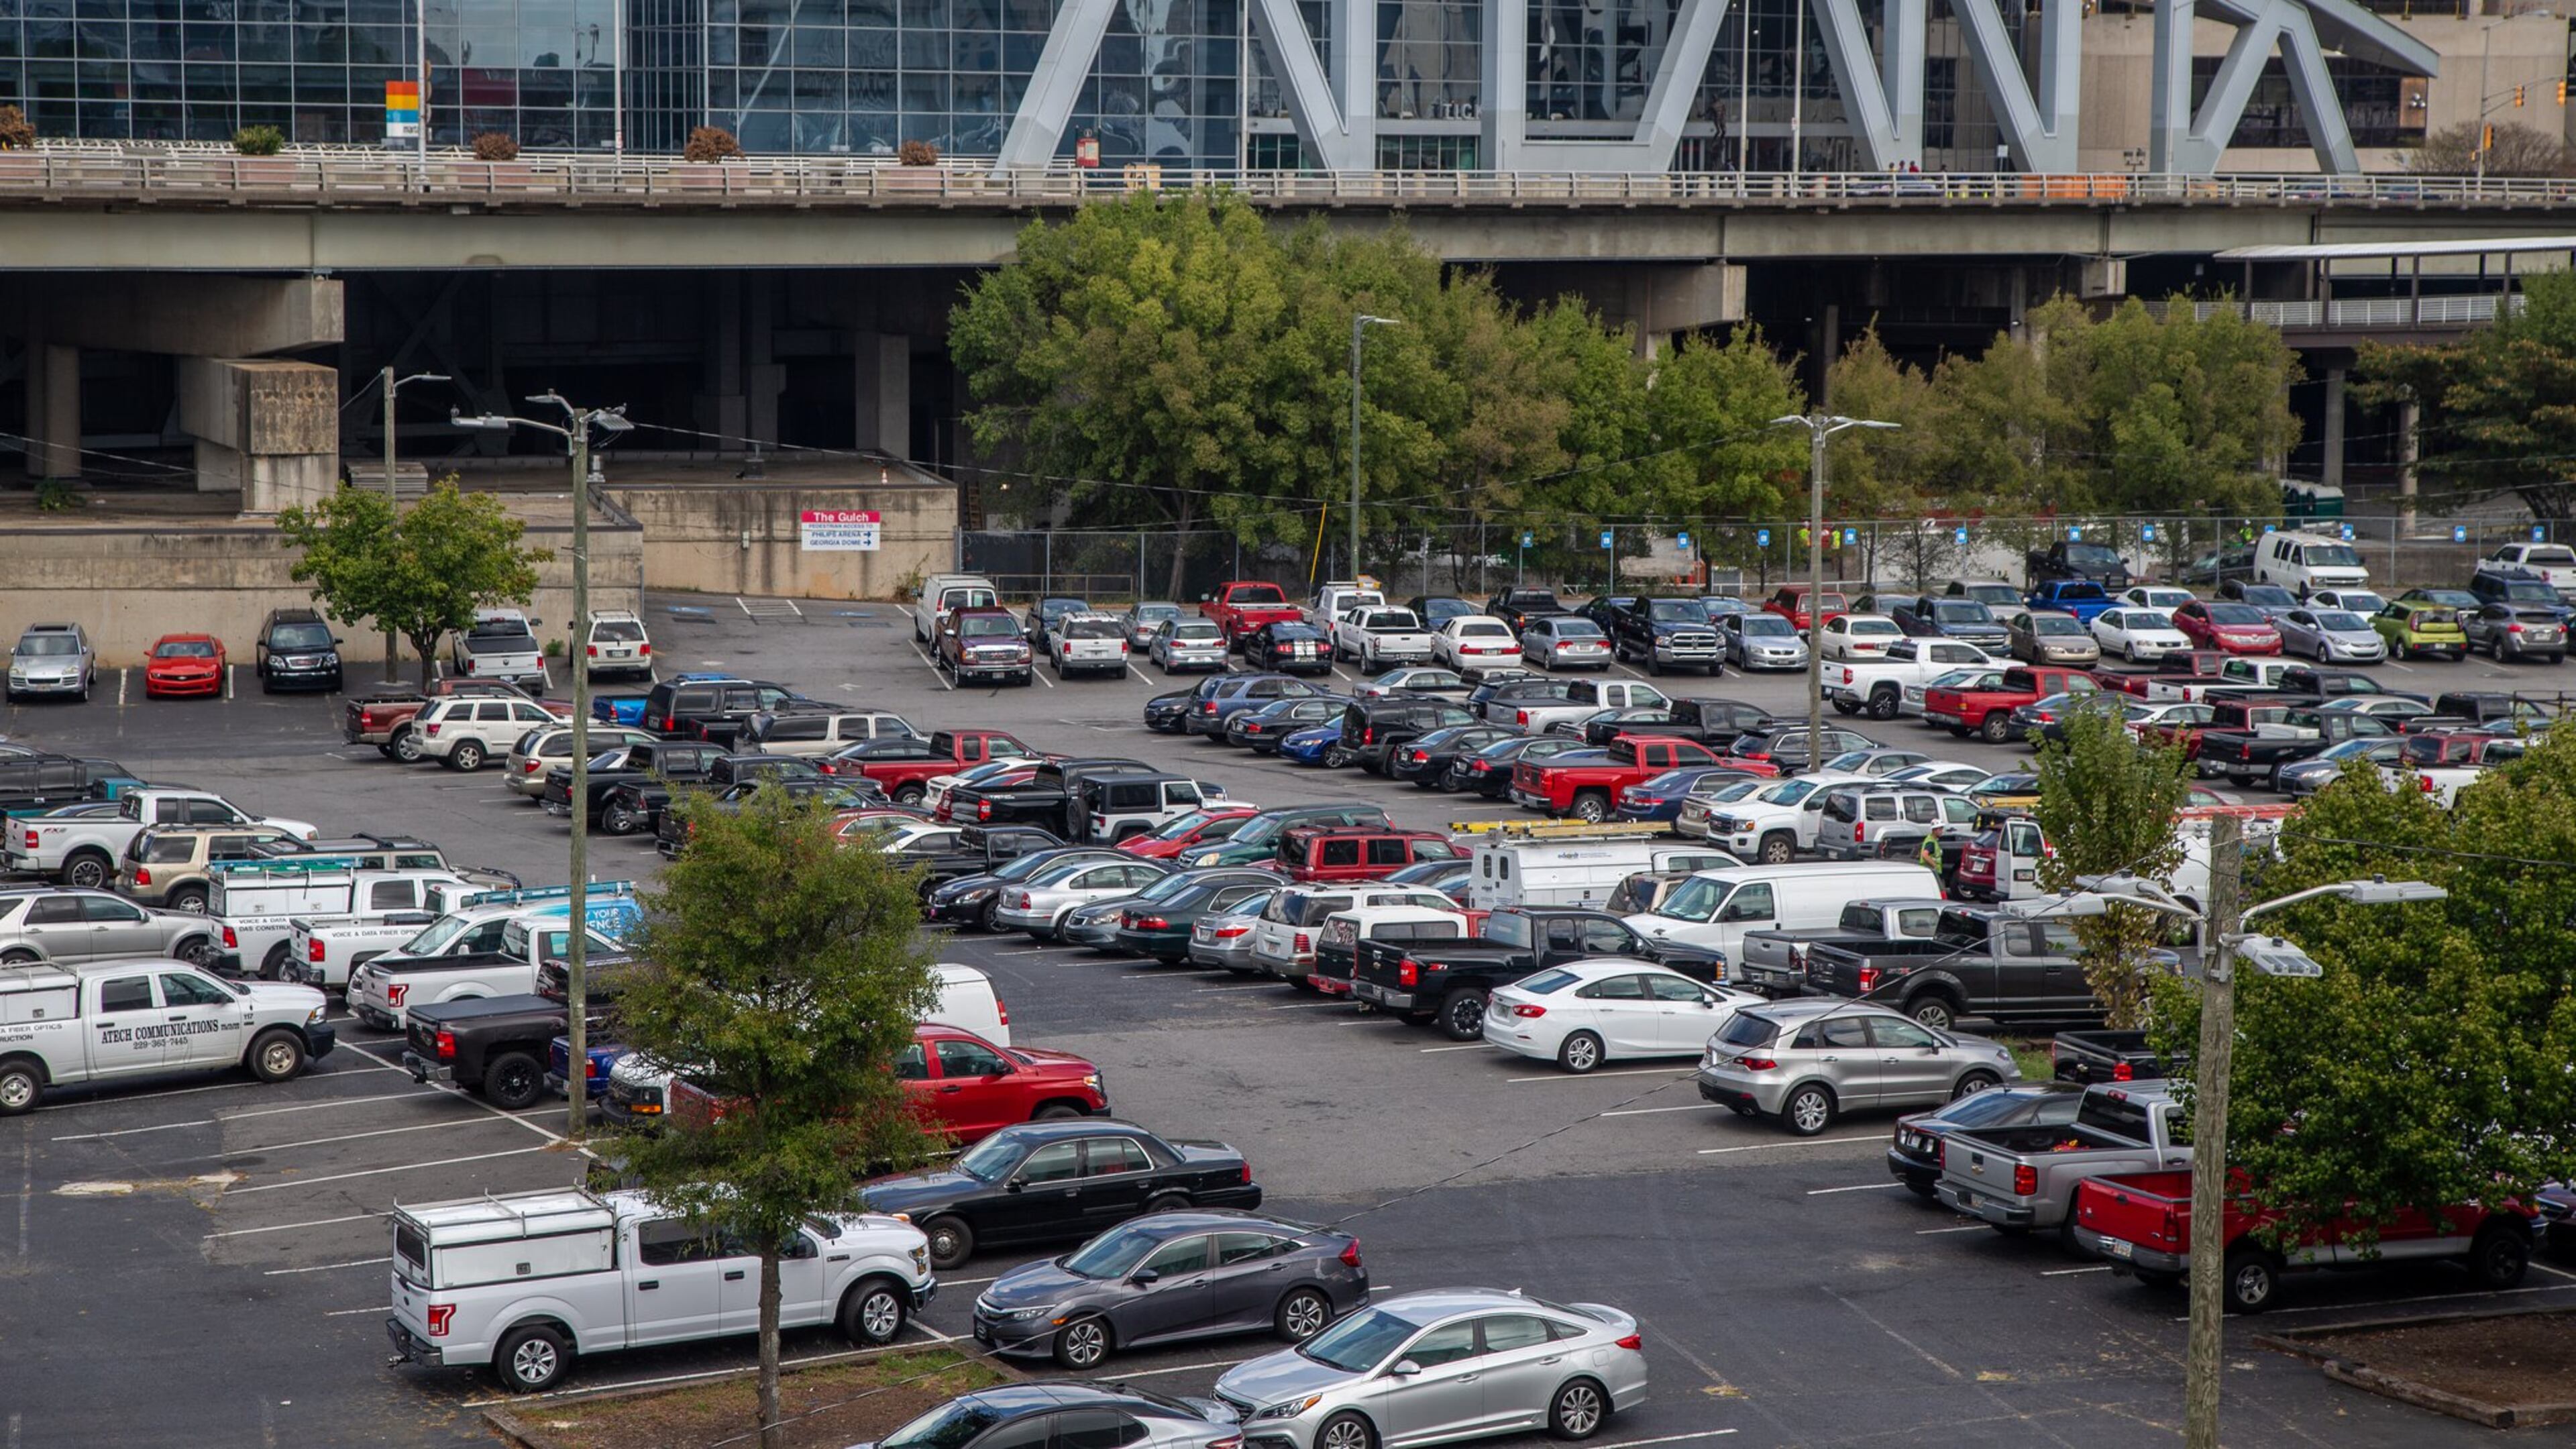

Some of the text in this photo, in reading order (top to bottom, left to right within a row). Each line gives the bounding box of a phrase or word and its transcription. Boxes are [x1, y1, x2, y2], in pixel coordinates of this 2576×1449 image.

[813, 512, 869, 522] The Gulch
[594, 908, 619, 918] YOUR
[101, 1028, 132, 1044] ATECH
[135, 1019, 219, 1040] COMMUNICATIONS
